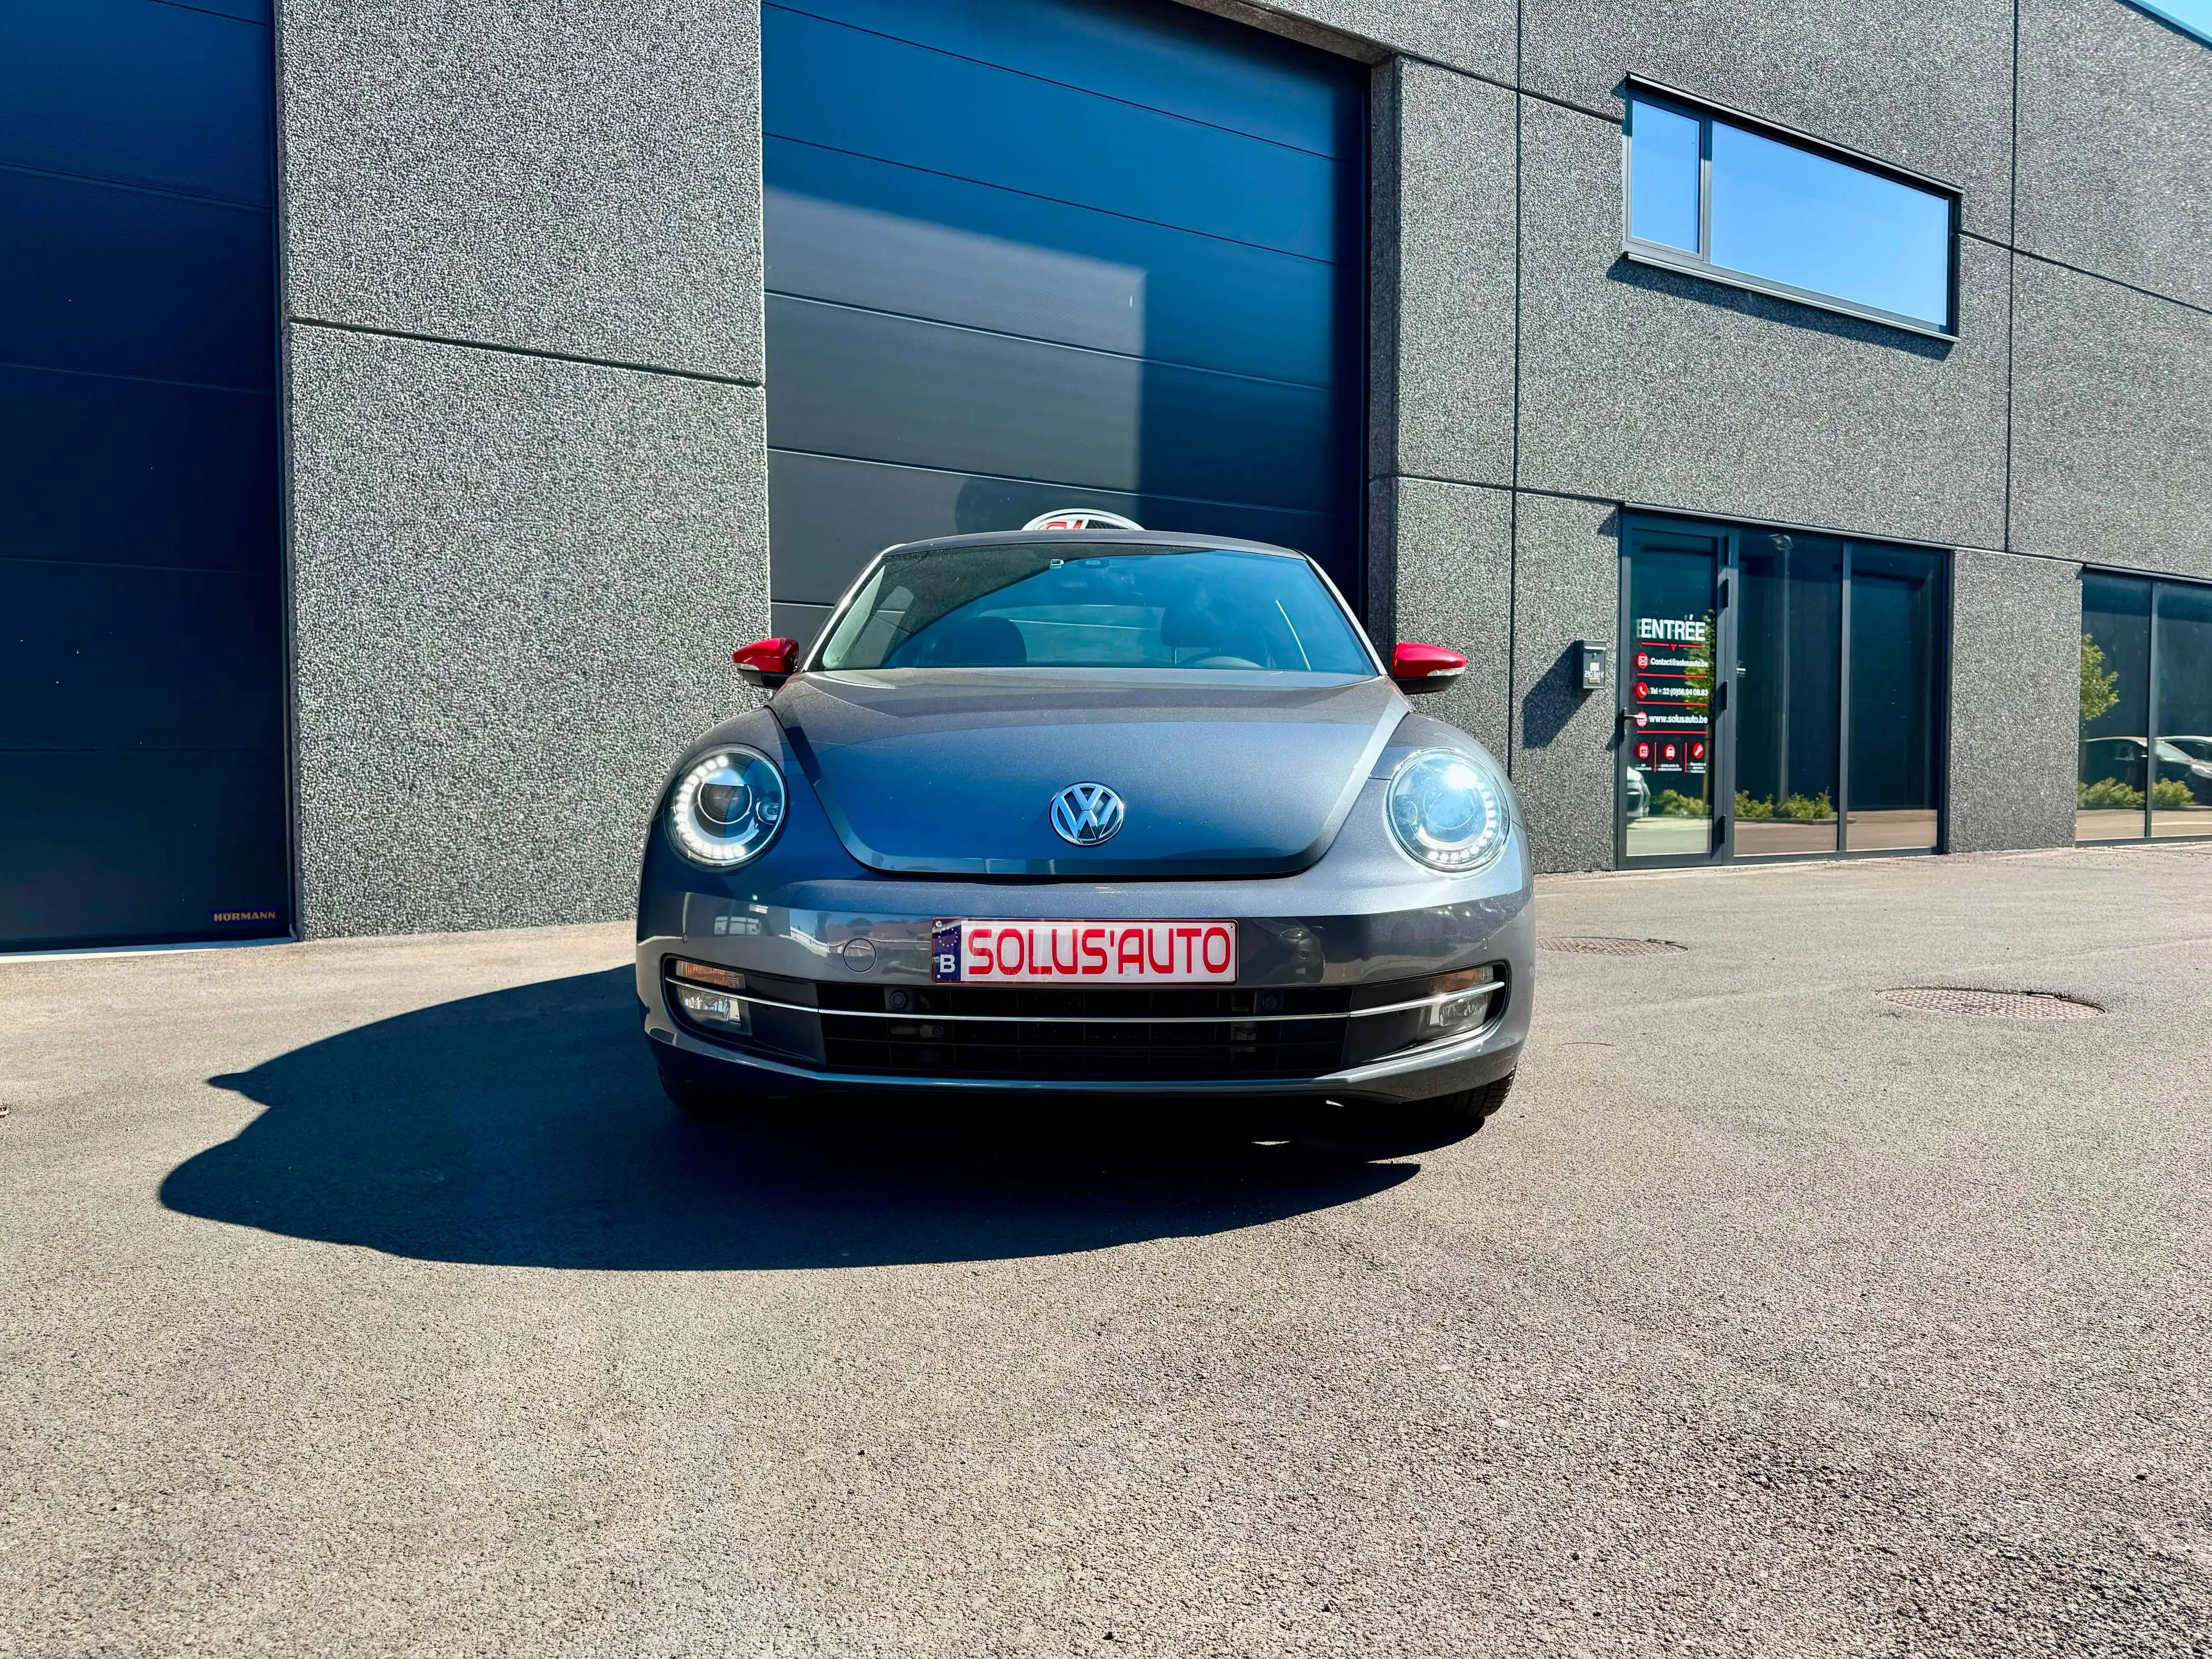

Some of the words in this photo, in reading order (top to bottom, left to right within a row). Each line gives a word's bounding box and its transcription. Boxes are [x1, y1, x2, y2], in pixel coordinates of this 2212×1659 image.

[1641, 614, 1706, 641] ENTRÉE
[1649, 714, 1709, 724] www.solusauto.be
[940, 953, 956, 974] B
[968, 927, 1231, 975] SOLUS'AUTO
